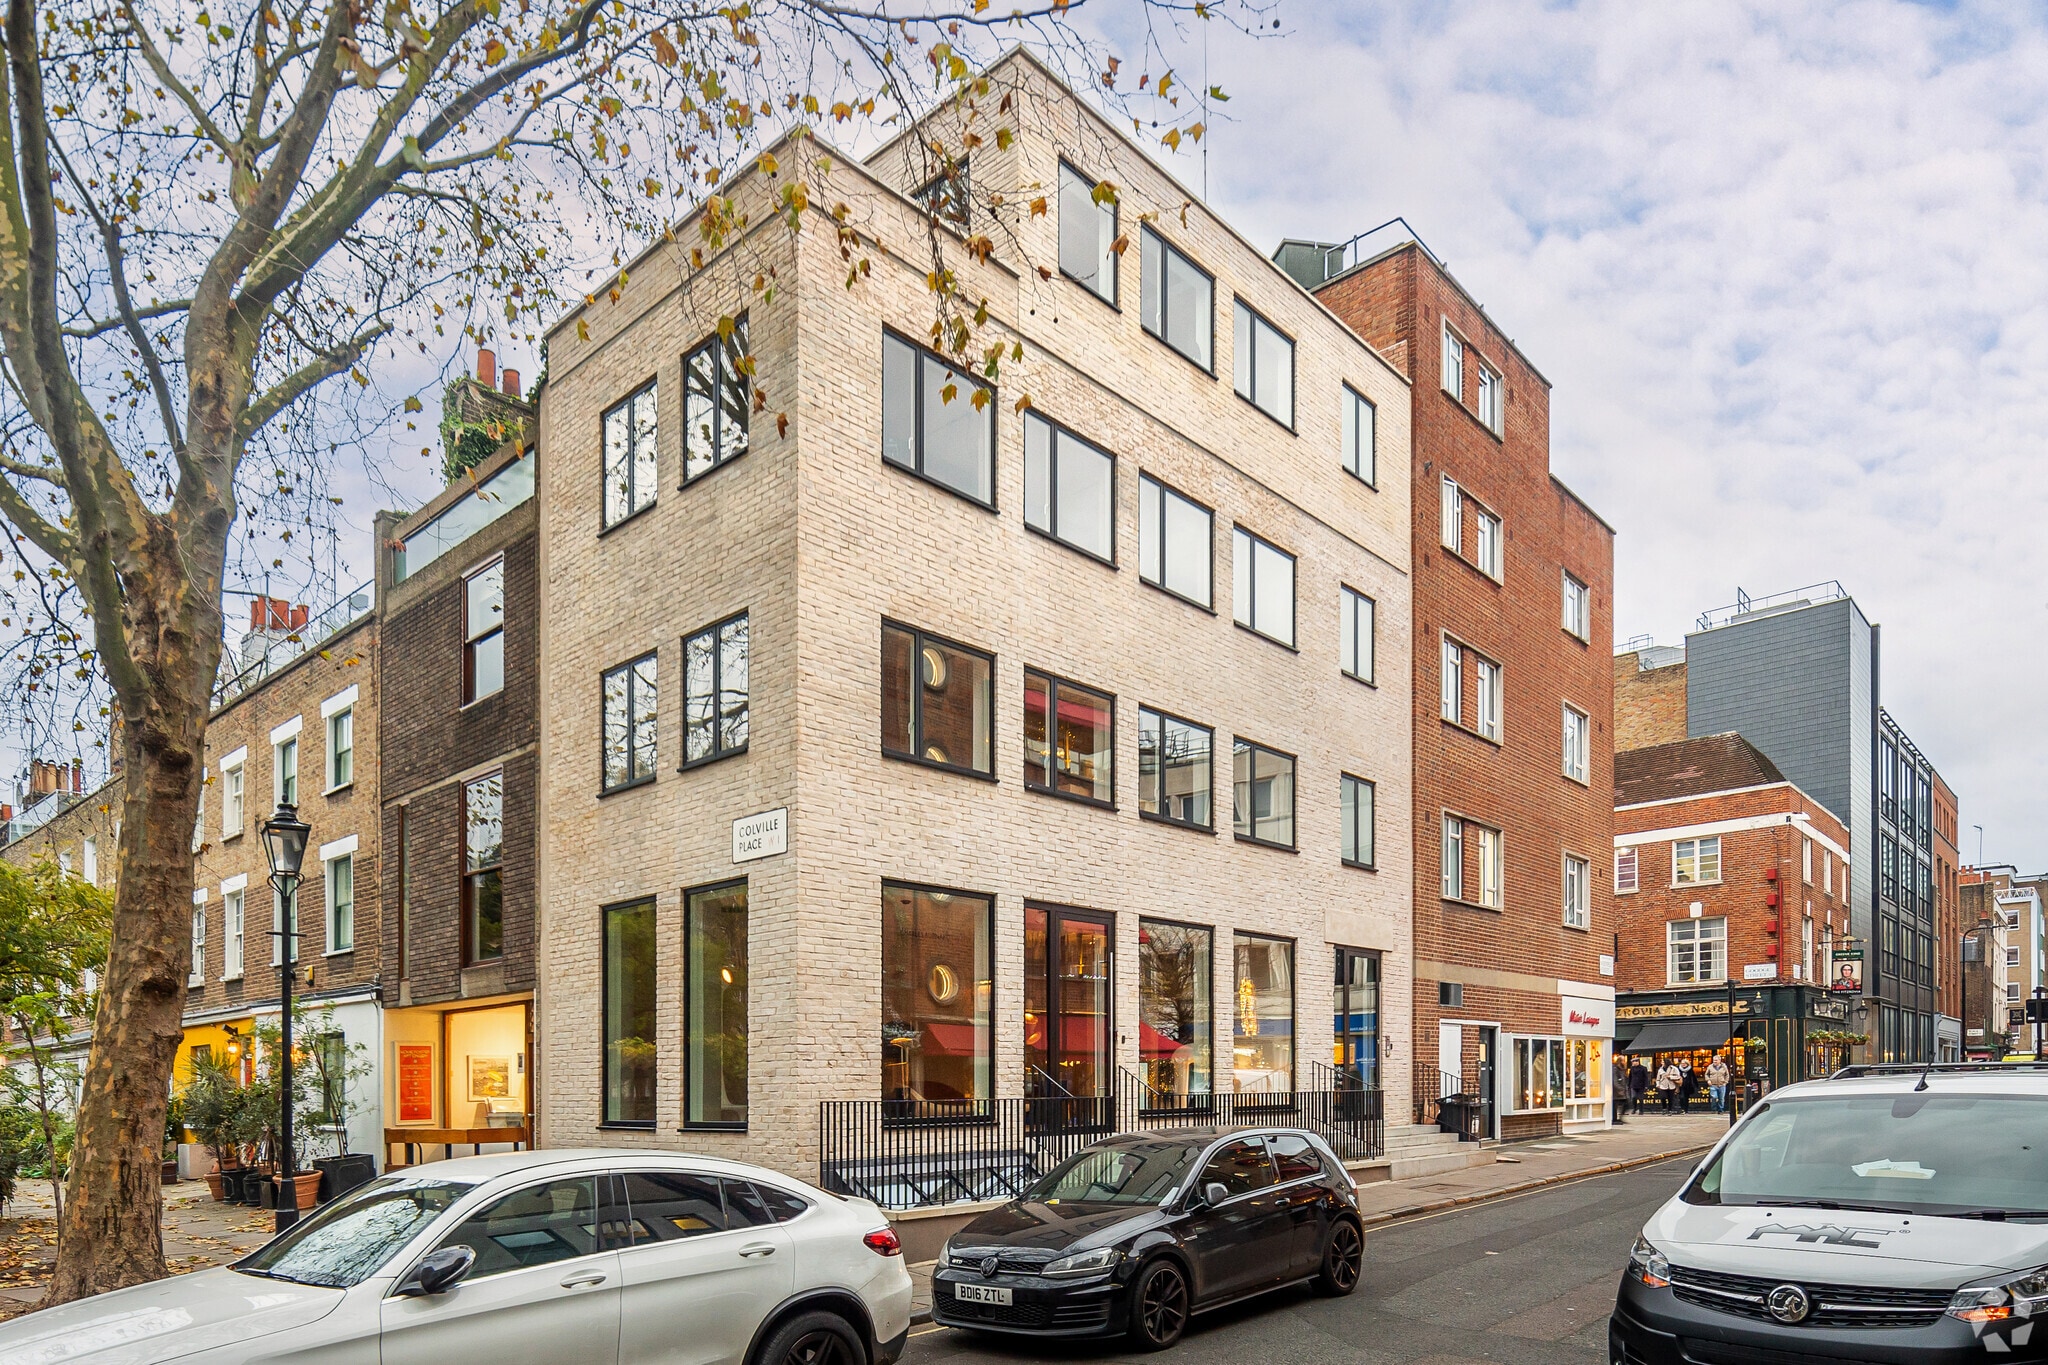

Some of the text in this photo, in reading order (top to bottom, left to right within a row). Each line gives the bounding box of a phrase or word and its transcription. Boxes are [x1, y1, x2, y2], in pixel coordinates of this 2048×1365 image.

[739, 819, 778, 838] COLVILLE
[739, 838, 762, 853] PLACE
[960, 1285, 1004, 1302] BD16 ZTL
